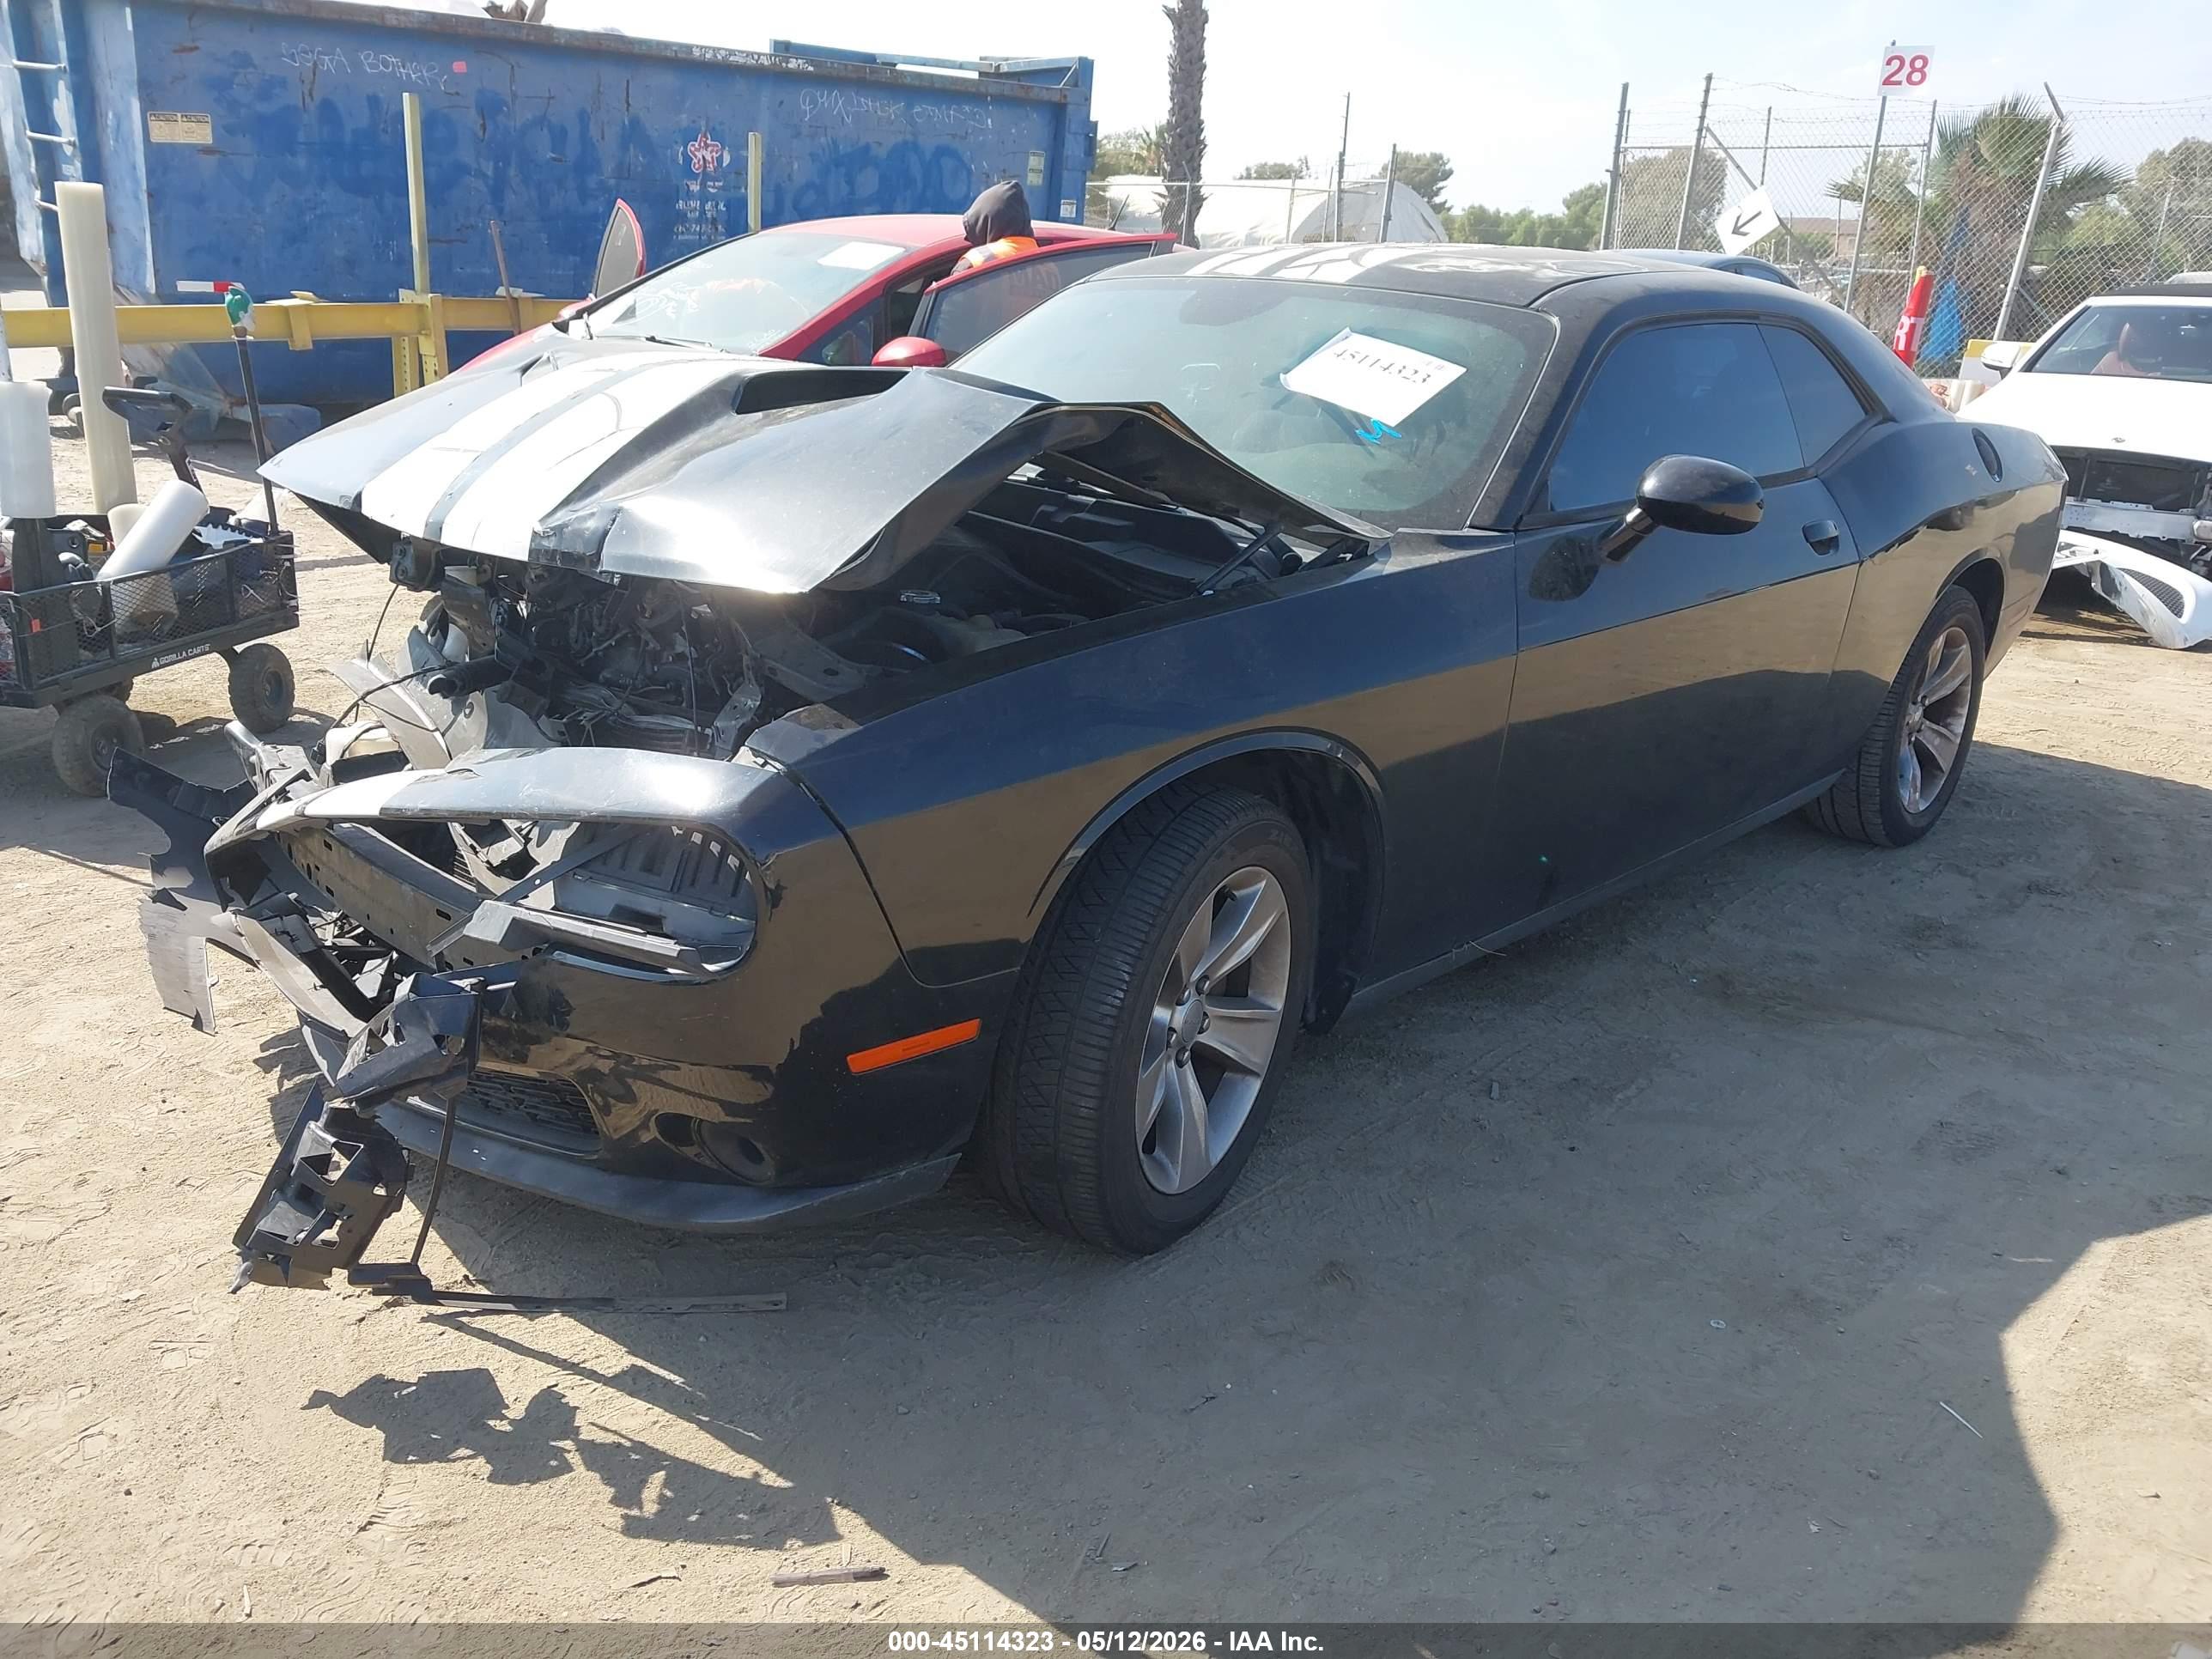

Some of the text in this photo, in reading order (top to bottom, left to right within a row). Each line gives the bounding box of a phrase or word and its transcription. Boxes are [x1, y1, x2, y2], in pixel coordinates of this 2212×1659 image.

[1881, 54, 1929, 86] 28
[159, 644, 210, 665] GORILLA CARTS
